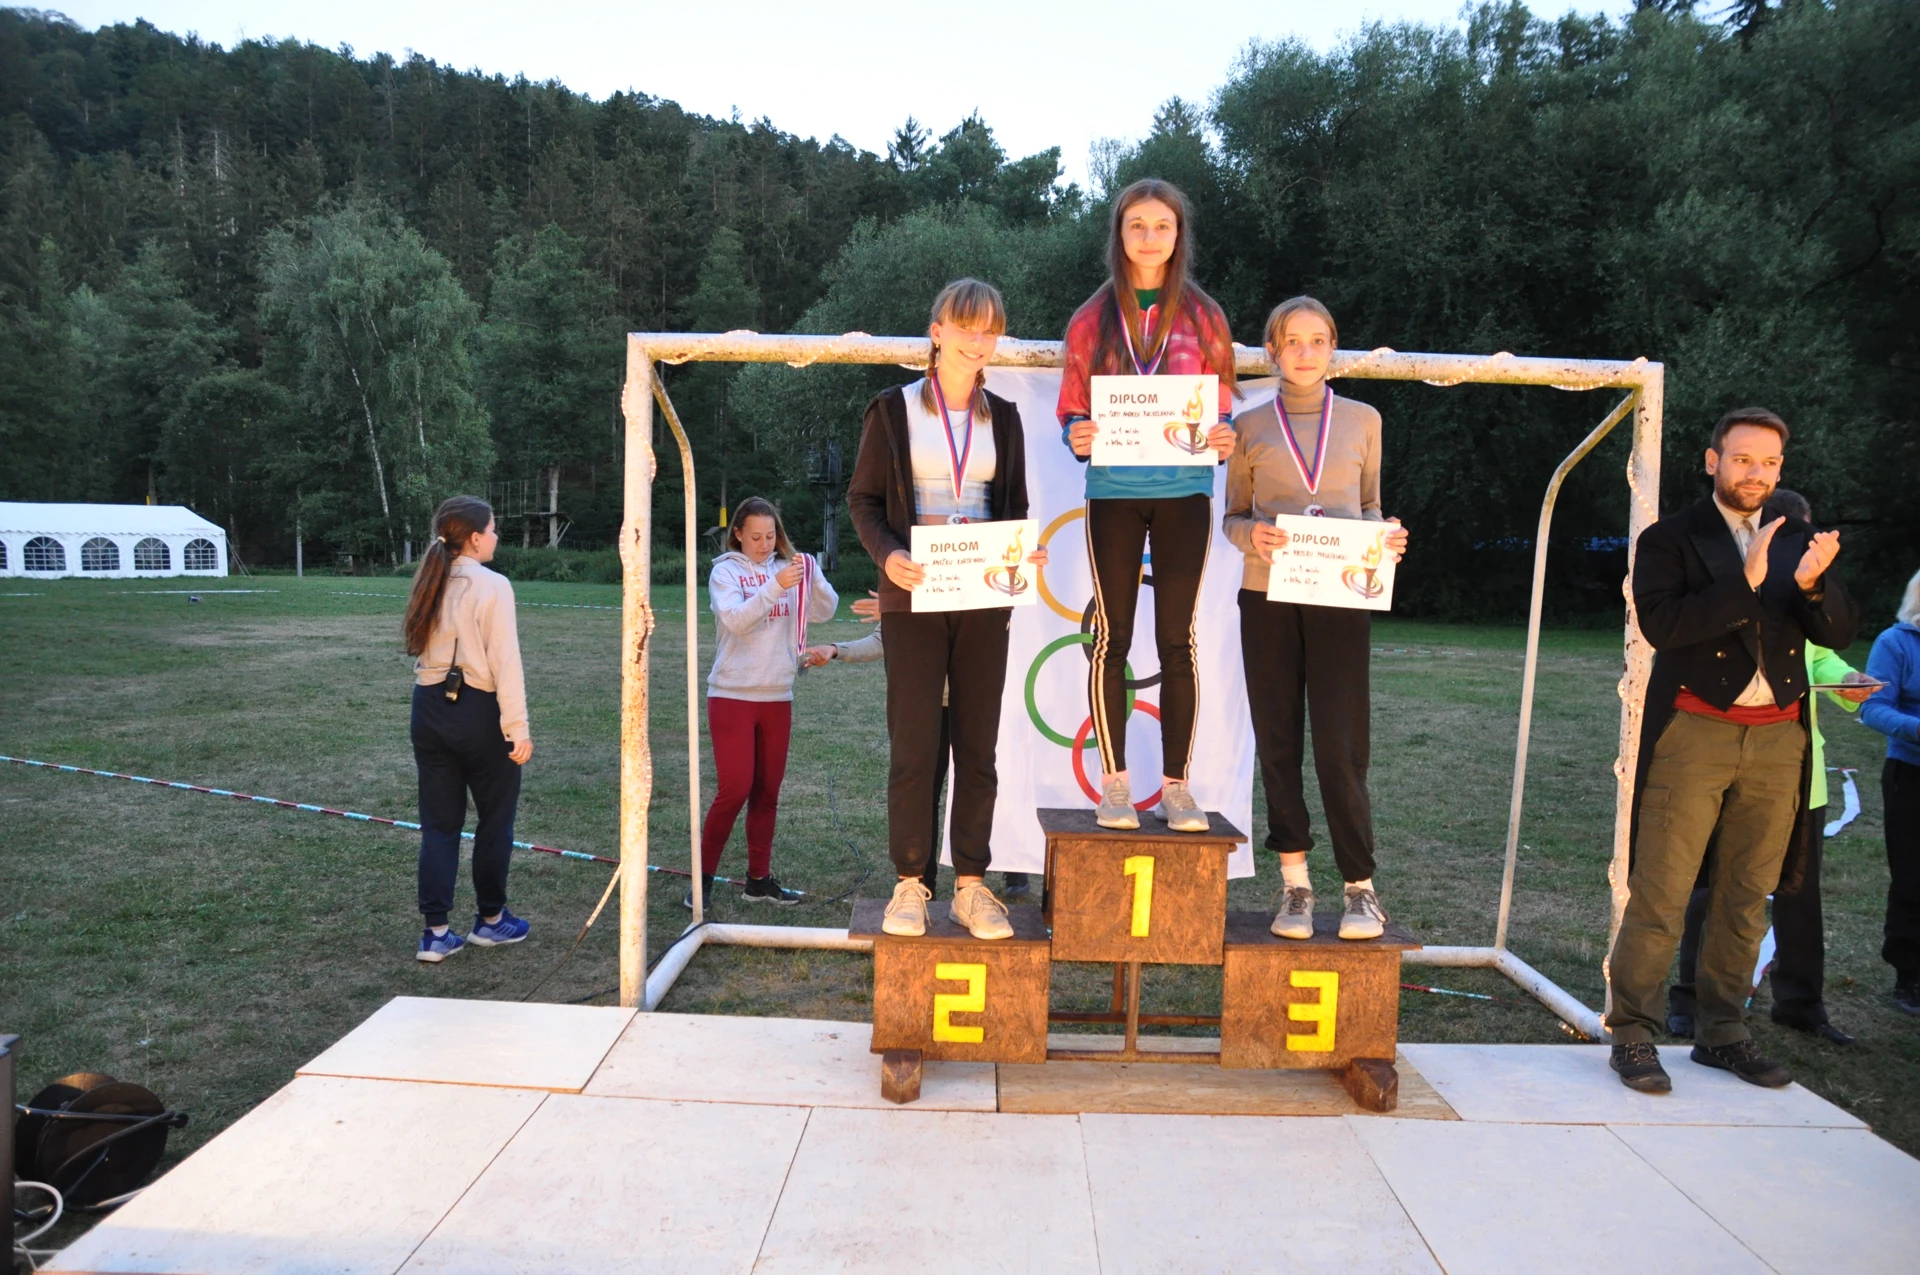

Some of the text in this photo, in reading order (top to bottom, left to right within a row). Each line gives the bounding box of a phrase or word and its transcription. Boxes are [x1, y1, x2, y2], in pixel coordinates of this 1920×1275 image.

[1109, 393, 1159, 404] DIPLOM
[930, 541, 979, 553] DIPLOM
[1292, 533, 1340, 547] DIPLOM
[1123, 855, 1155, 938] 1
[932, 962, 987, 1043] 2
[1285, 970, 1340, 1053] 3
